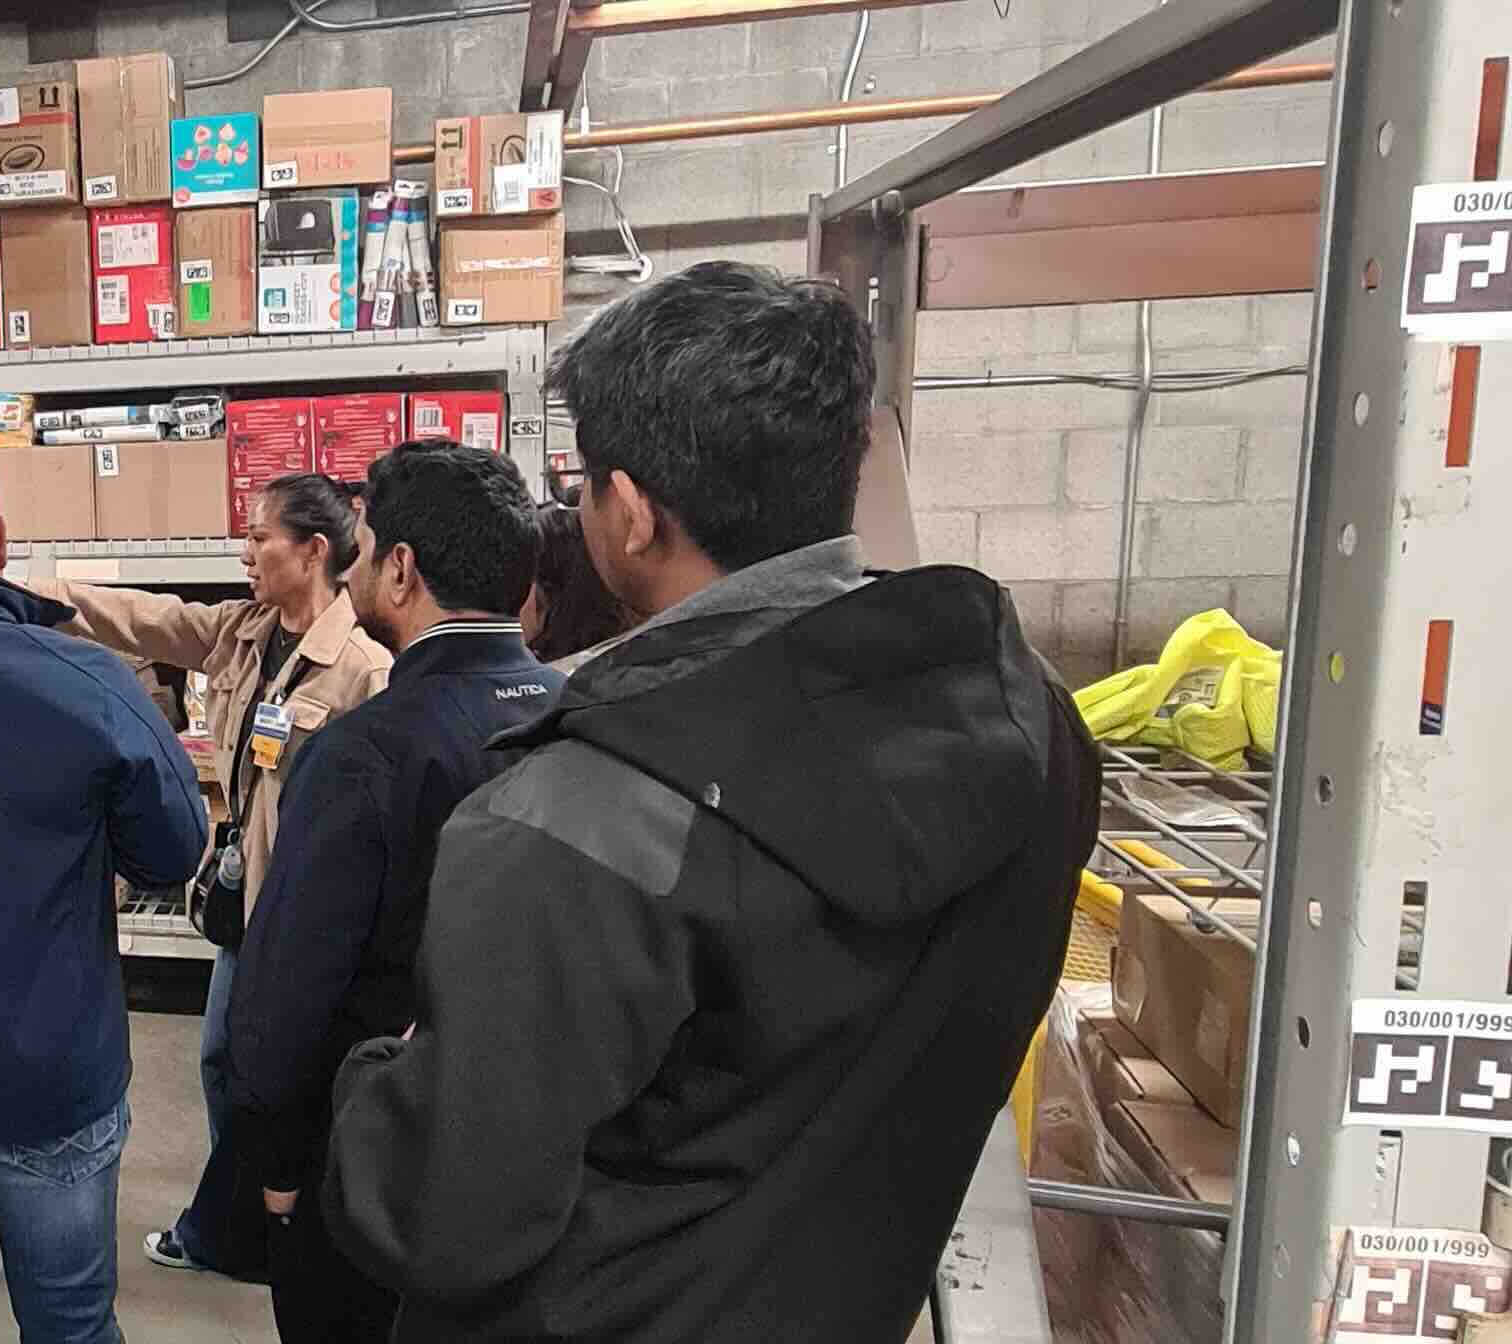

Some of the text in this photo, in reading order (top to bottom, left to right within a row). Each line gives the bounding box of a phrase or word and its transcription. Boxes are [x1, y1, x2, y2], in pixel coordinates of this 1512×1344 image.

[495, 684, 548, 700] NAUTICA
[1384, 1009, 1512, 1033] 030/001/999
[1360, 1233, 1490, 1258] 030/001/999
